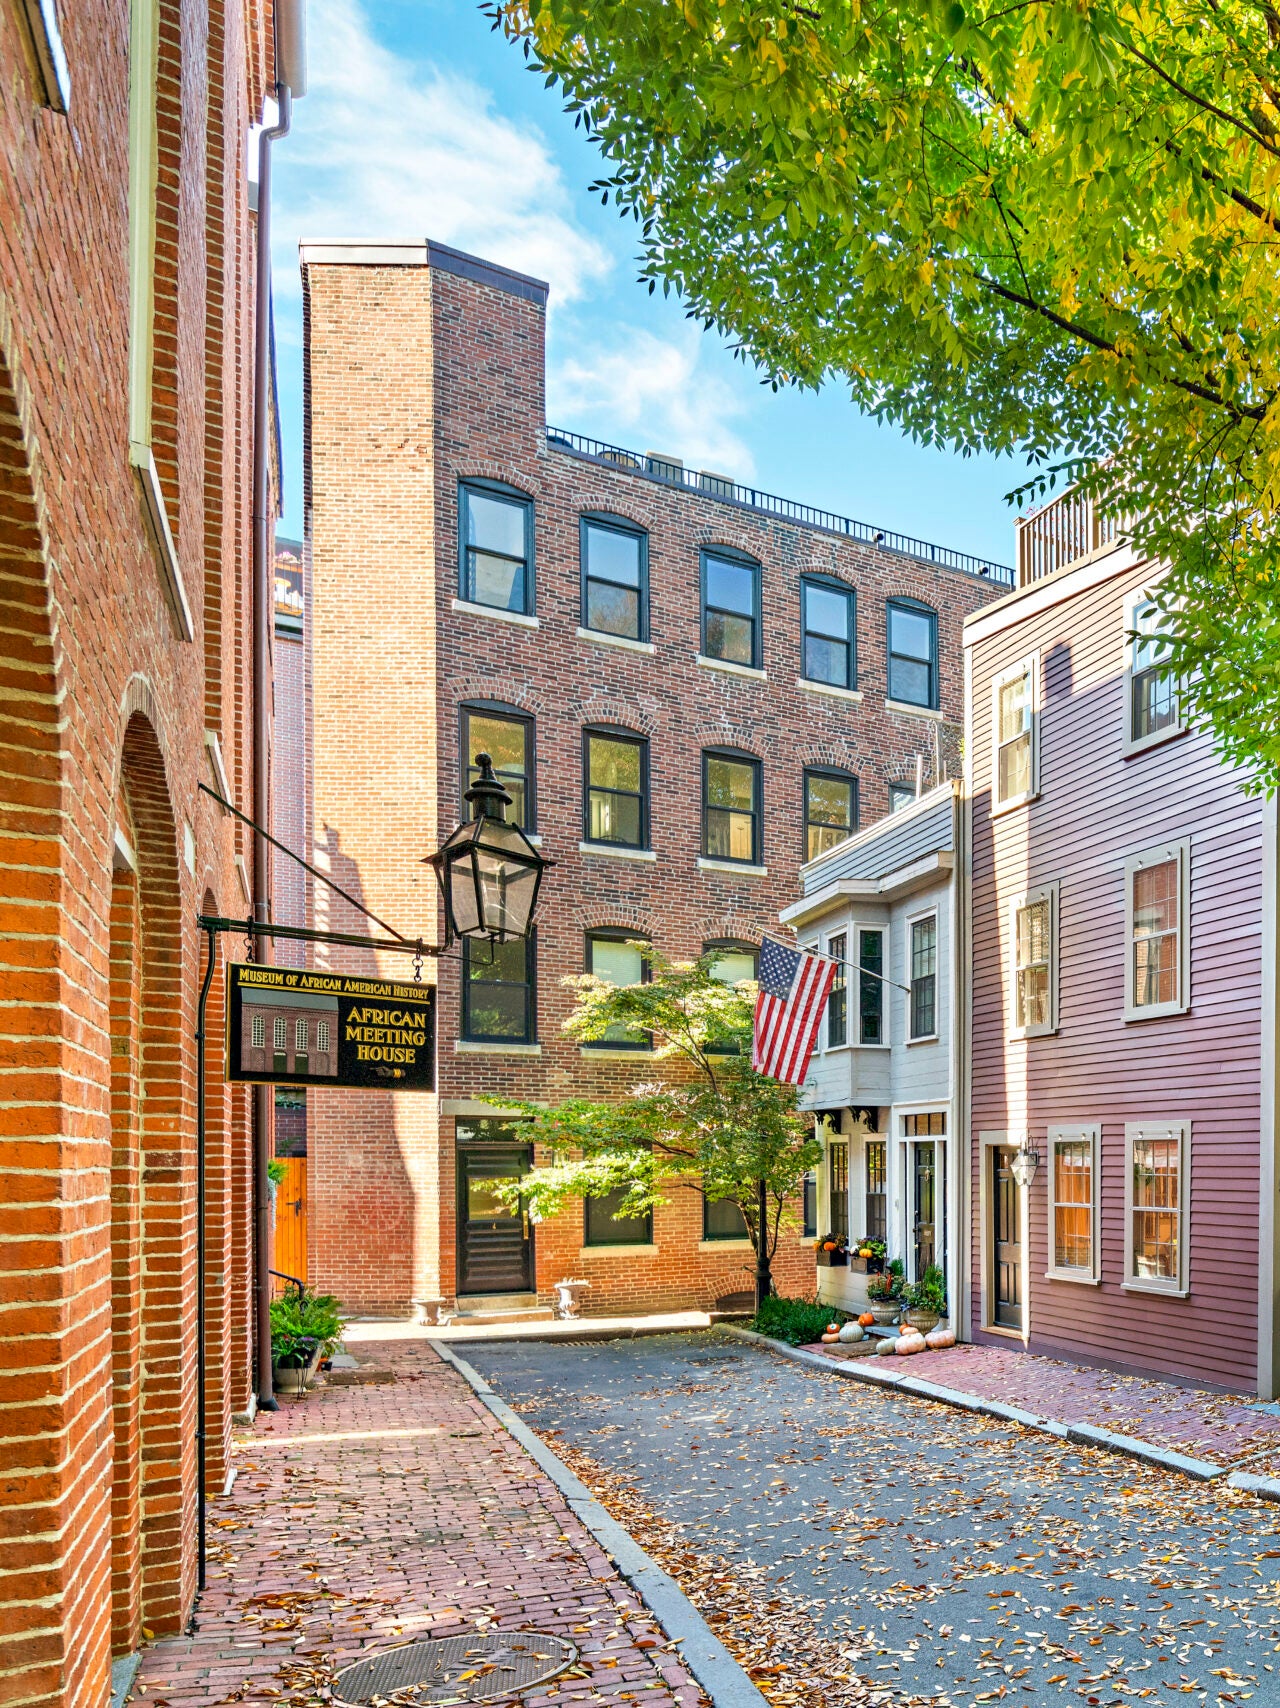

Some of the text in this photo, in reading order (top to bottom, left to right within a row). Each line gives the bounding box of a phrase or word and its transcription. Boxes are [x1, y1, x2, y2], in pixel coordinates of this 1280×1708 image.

[239, 968, 429, 999] MUSEUM OF AFRICAN AMERICAN HISTORY
[346, 1006, 426, 1028] AFRICAN
[345, 1025, 426, 1046] MEETING
[357, 1044, 416, 1063] HOUSE
